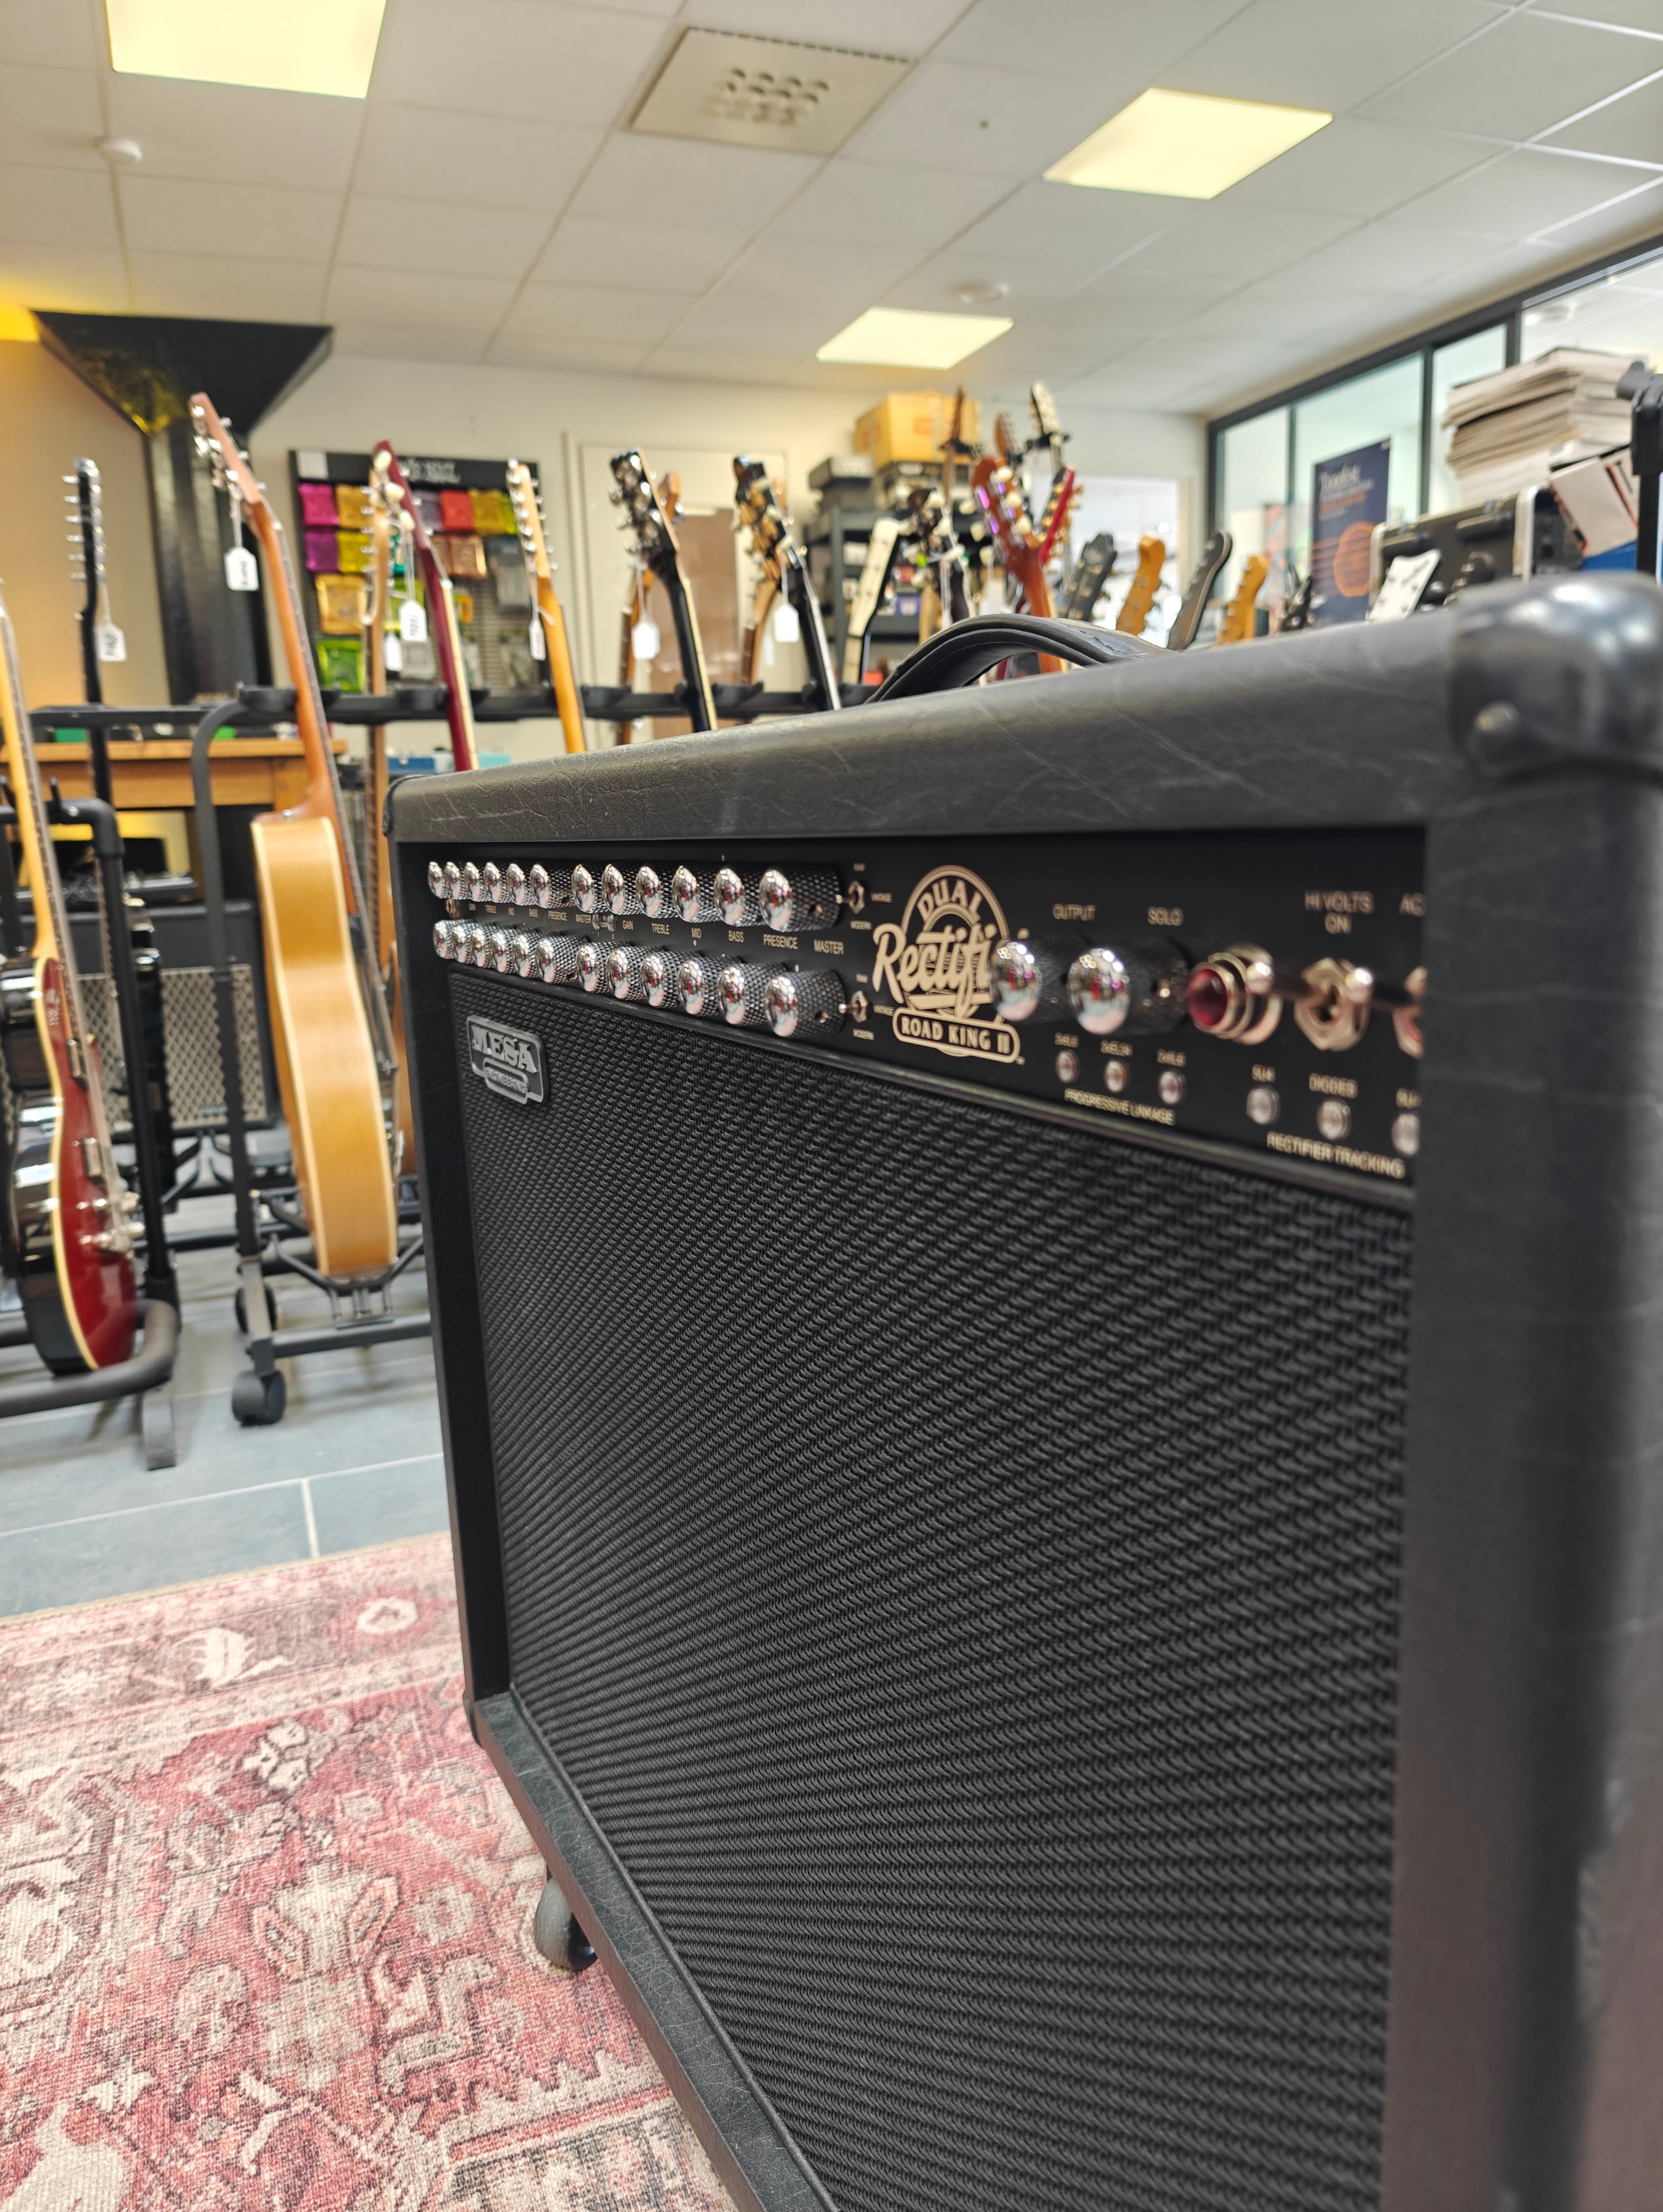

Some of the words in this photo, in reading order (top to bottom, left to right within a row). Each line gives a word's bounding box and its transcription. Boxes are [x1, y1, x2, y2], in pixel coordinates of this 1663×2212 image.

[917, 879, 983, 922] DUAL
[1305, 891, 1320, 910] HI
[1321, 891, 1374, 914] VOLTS
[529, 909, 538, 917] BASS
[548, 910, 567, 921] PRESENCE
[576, 914, 592, 924] MASTER
[1053, 904, 1096, 921] OUTPUT
[1148, 906, 1183, 926] SOLO
[623, 920, 634, 931] GAIN
[651, 923, 670, 935] TREBLE
[1325, 912, 1352, 934] ON
[692, 928, 702, 939] MID
[728, 930, 744, 943] BASS
[763, 934, 798, 950] PRESENCE
[814, 940, 845, 956] MASTER
[901, 1016, 943, 1041] ROAD
[948, 1024, 992, 1051] KING
[997, 1032, 1011, 1054] II
[472, 1025, 539, 1074] MESA
[1309, 1072, 1358, 1099] DIODES
[1064, 1088, 1130, 1115] PROGRESSIVE
[1130, 1103, 1176, 1125] LINKAGE
[1267, 1131, 1334, 1161] RECTIFIER
[1333, 1145, 1406, 1179] TRACKING
